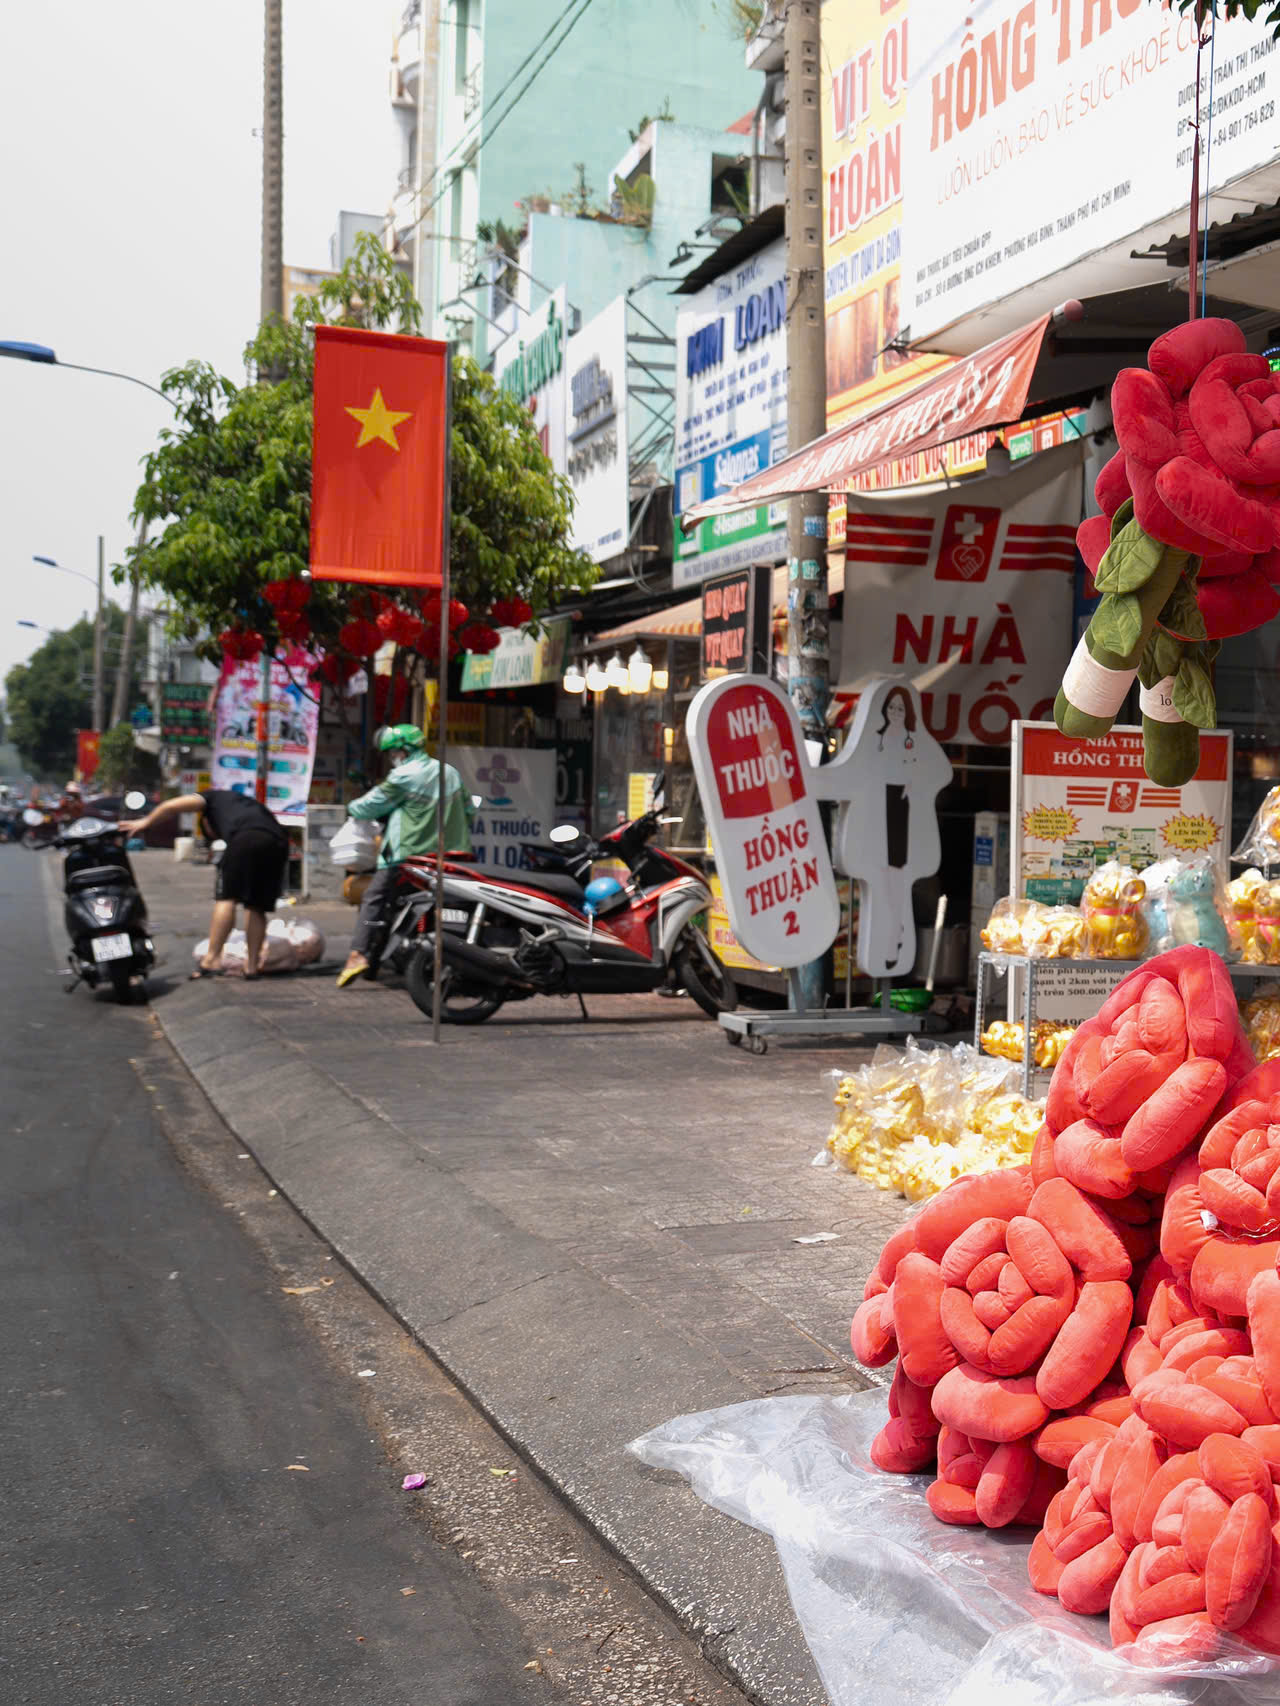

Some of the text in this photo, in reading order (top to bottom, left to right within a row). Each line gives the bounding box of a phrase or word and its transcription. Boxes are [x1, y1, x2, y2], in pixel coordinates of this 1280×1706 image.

[832, 48, 872, 138] VỊT
[1229, 119, 1242, 140] 901
[1244, 111, 1258, 132] 764
[1260, 100, 1275, 123] 828
[986, 355, 1017, 410] 2
[892, 602, 1027, 665] NHÀ
[727, 696, 774, 740] NHÀ
[1086, 735, 1117, 748] NHÀ
[720, 743, 795, 794] THUỐC
[491, 815, 541, 837] THUỐC
[743, 816, 810, 871] HỒNG
[745, 857, 820, 917] THUẬN
[783, 911, 801, 937] 2
[1067, 987, 1107, 996] 500.000
